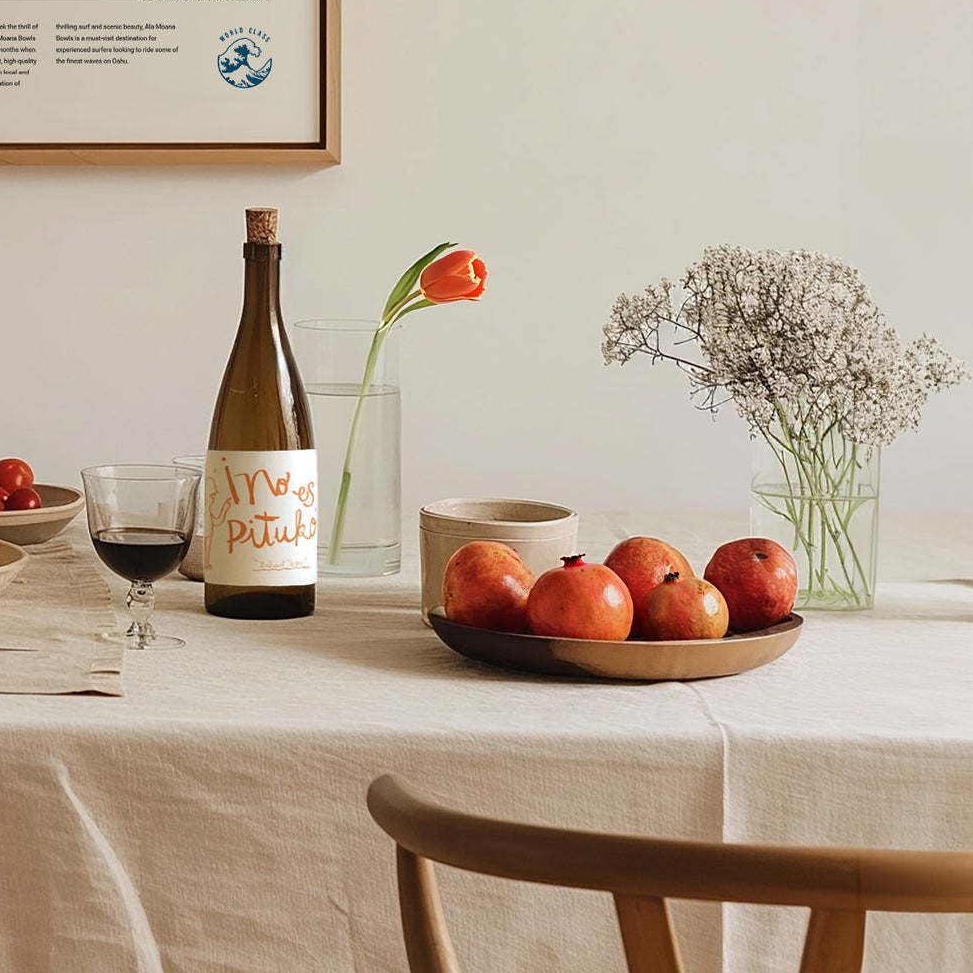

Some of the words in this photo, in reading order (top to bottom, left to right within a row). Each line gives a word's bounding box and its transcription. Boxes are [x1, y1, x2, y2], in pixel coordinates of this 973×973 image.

[55, 23, 78, 32] thrilling
[219, 27, 243, 42] WORLD
[248, 27, 270, 42] CLASS
[55, 45, 91, 54] experienced
[113, 46, 135, 55] looking
[3, 57, 37, 66] high-quality
[292, 481, 315, 507] es
